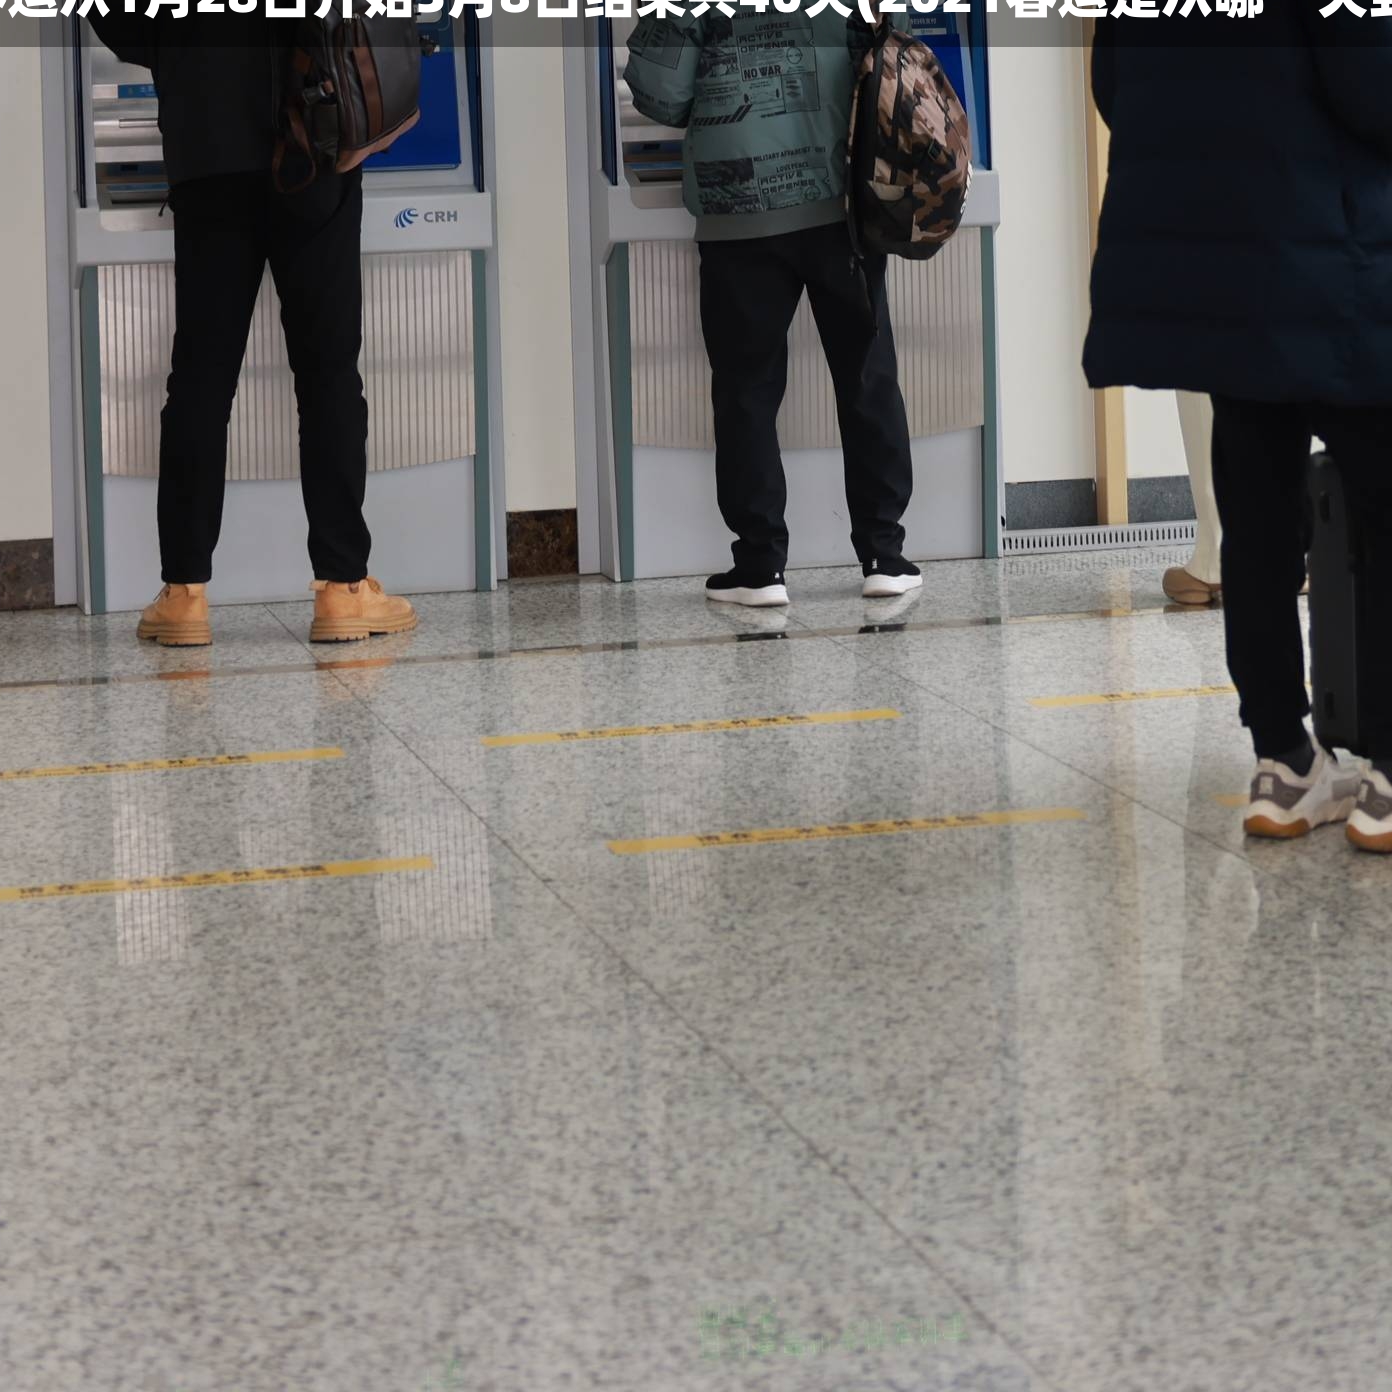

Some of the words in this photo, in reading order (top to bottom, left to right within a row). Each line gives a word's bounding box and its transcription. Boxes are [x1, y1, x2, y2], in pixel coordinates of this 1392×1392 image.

[743, 68, 758, 80] NO
[760, 65, 782, 77] WAR
[423, 210, 458, 223] CRH
